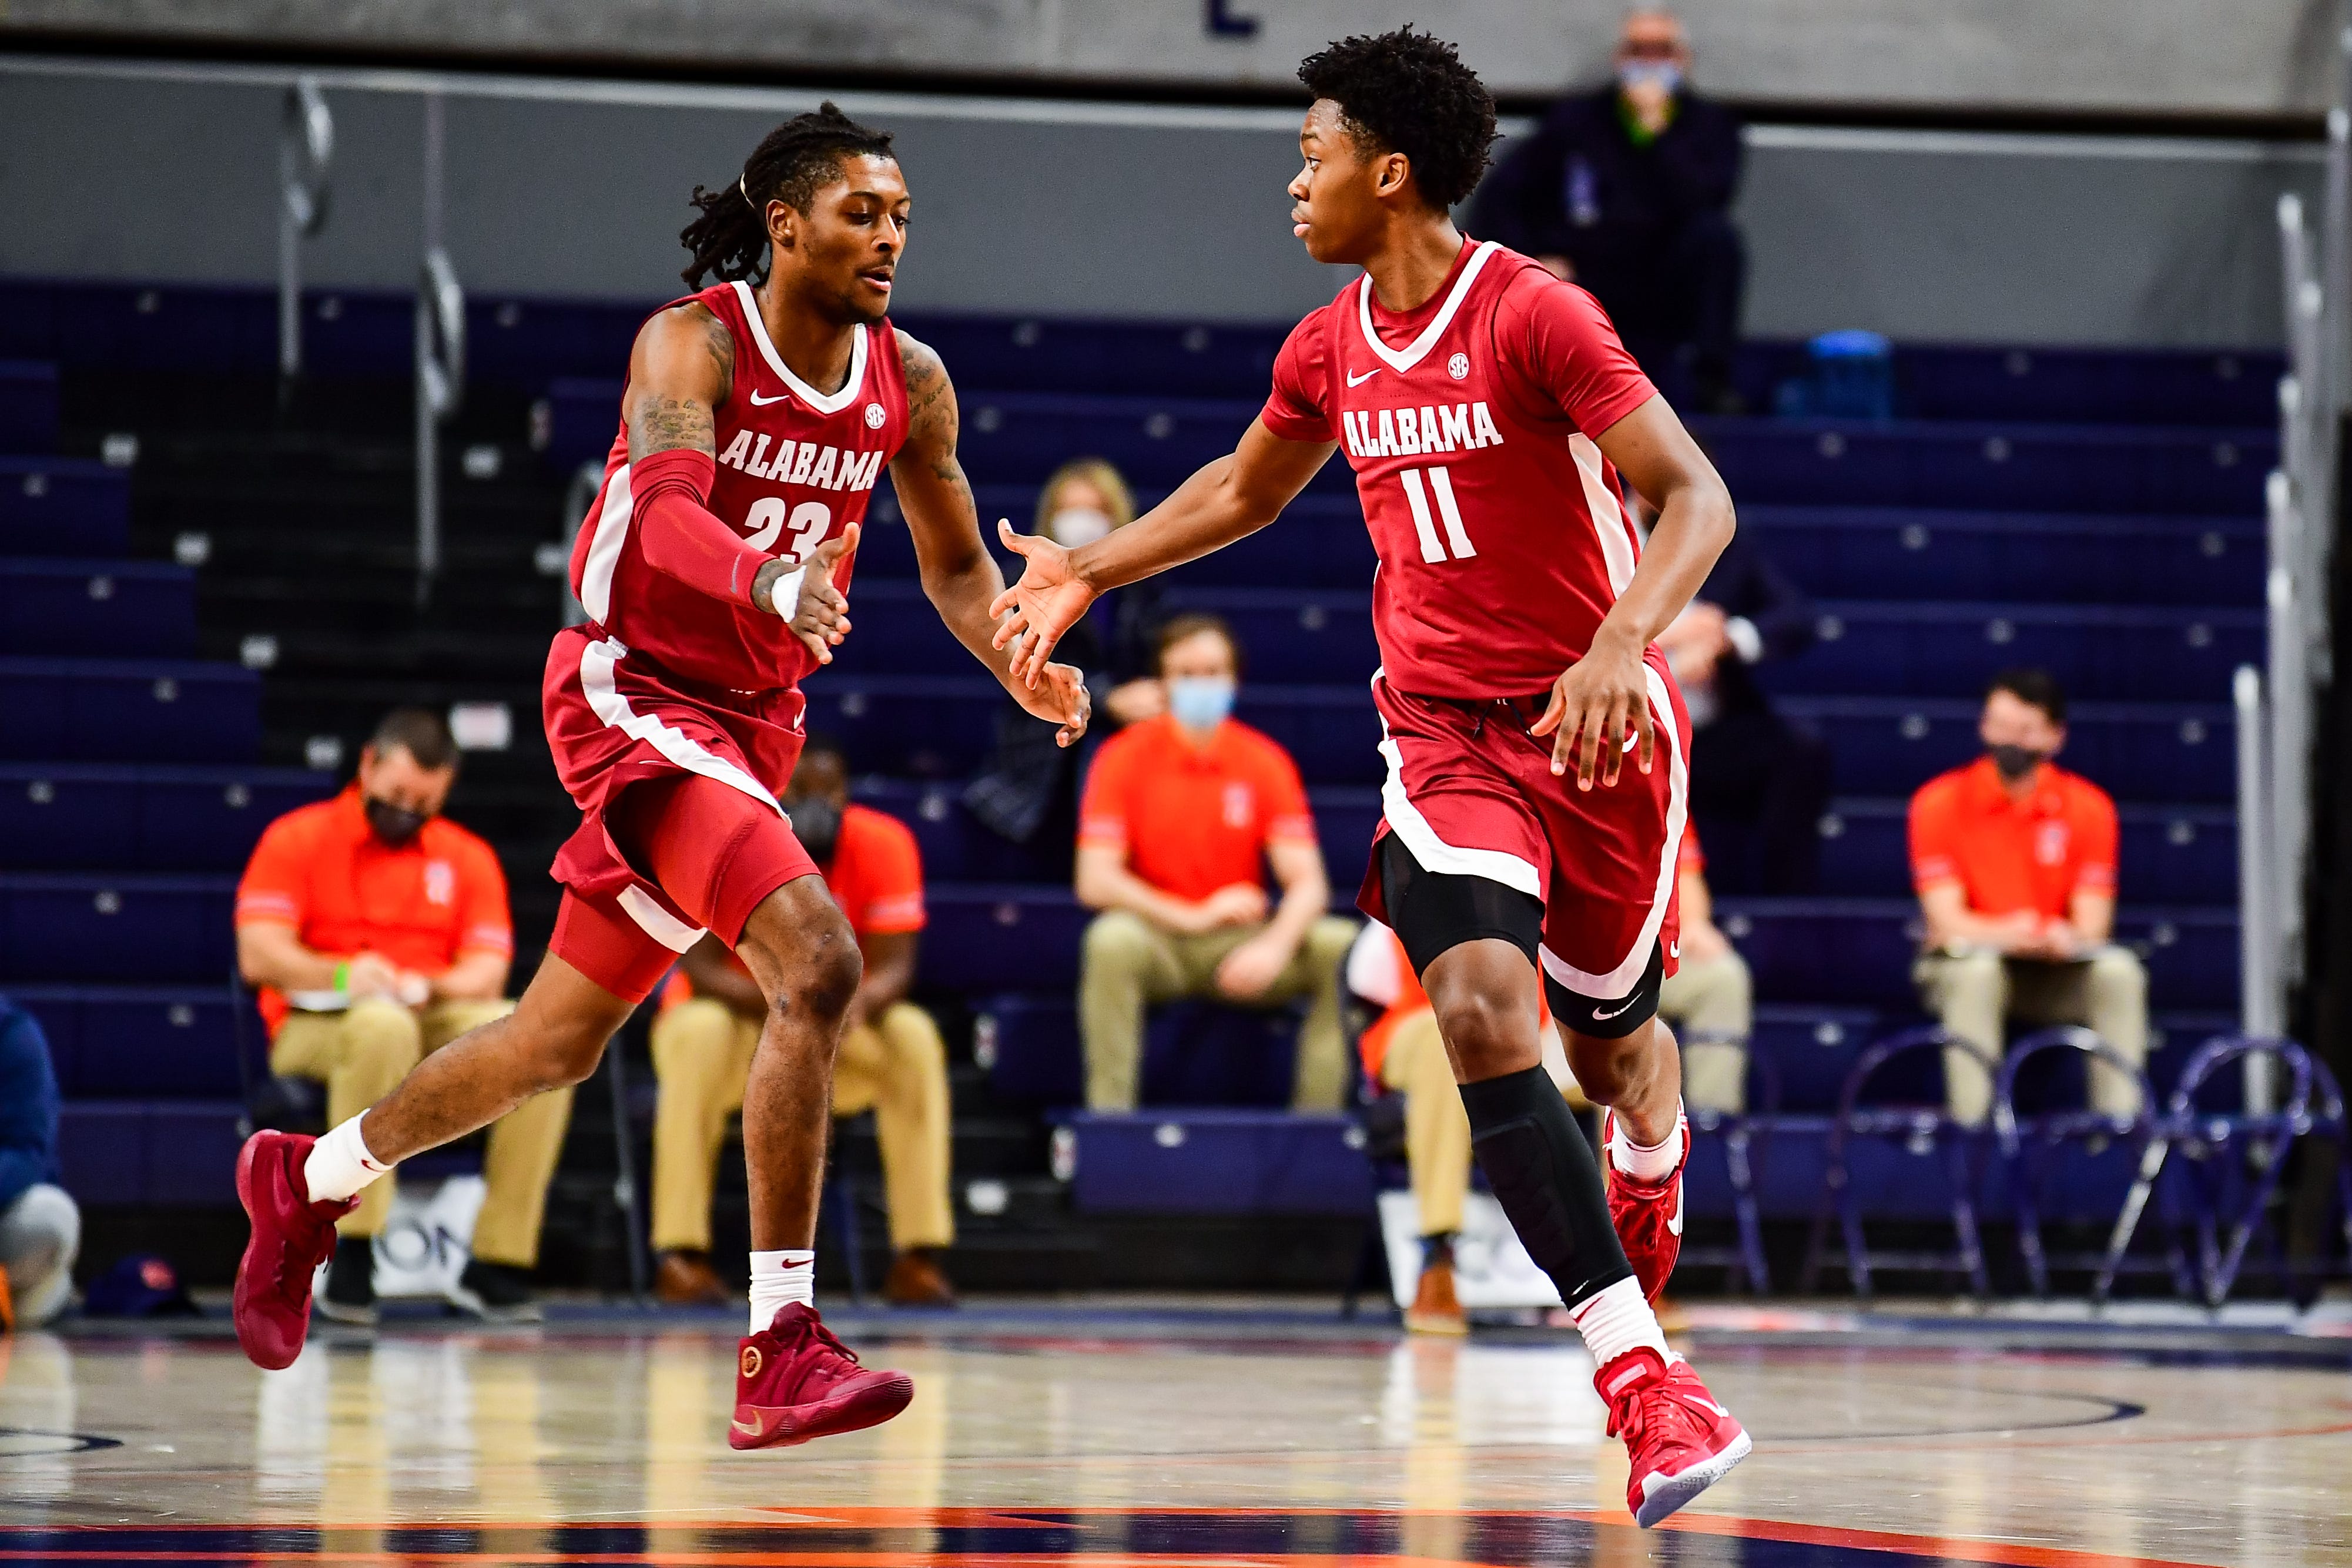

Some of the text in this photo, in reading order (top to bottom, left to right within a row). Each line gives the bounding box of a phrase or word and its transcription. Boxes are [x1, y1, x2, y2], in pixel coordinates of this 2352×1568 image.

[1449, 354, 1468, 378] SEC
[866, 405, 884, 427] SEC
[1343, 401, 1504, 457] ALABAMA
[718, 429, 884, 492] ALABAMA
[743, 497, 830, 564] 23
[1400, 466, 1477, 564] 11
